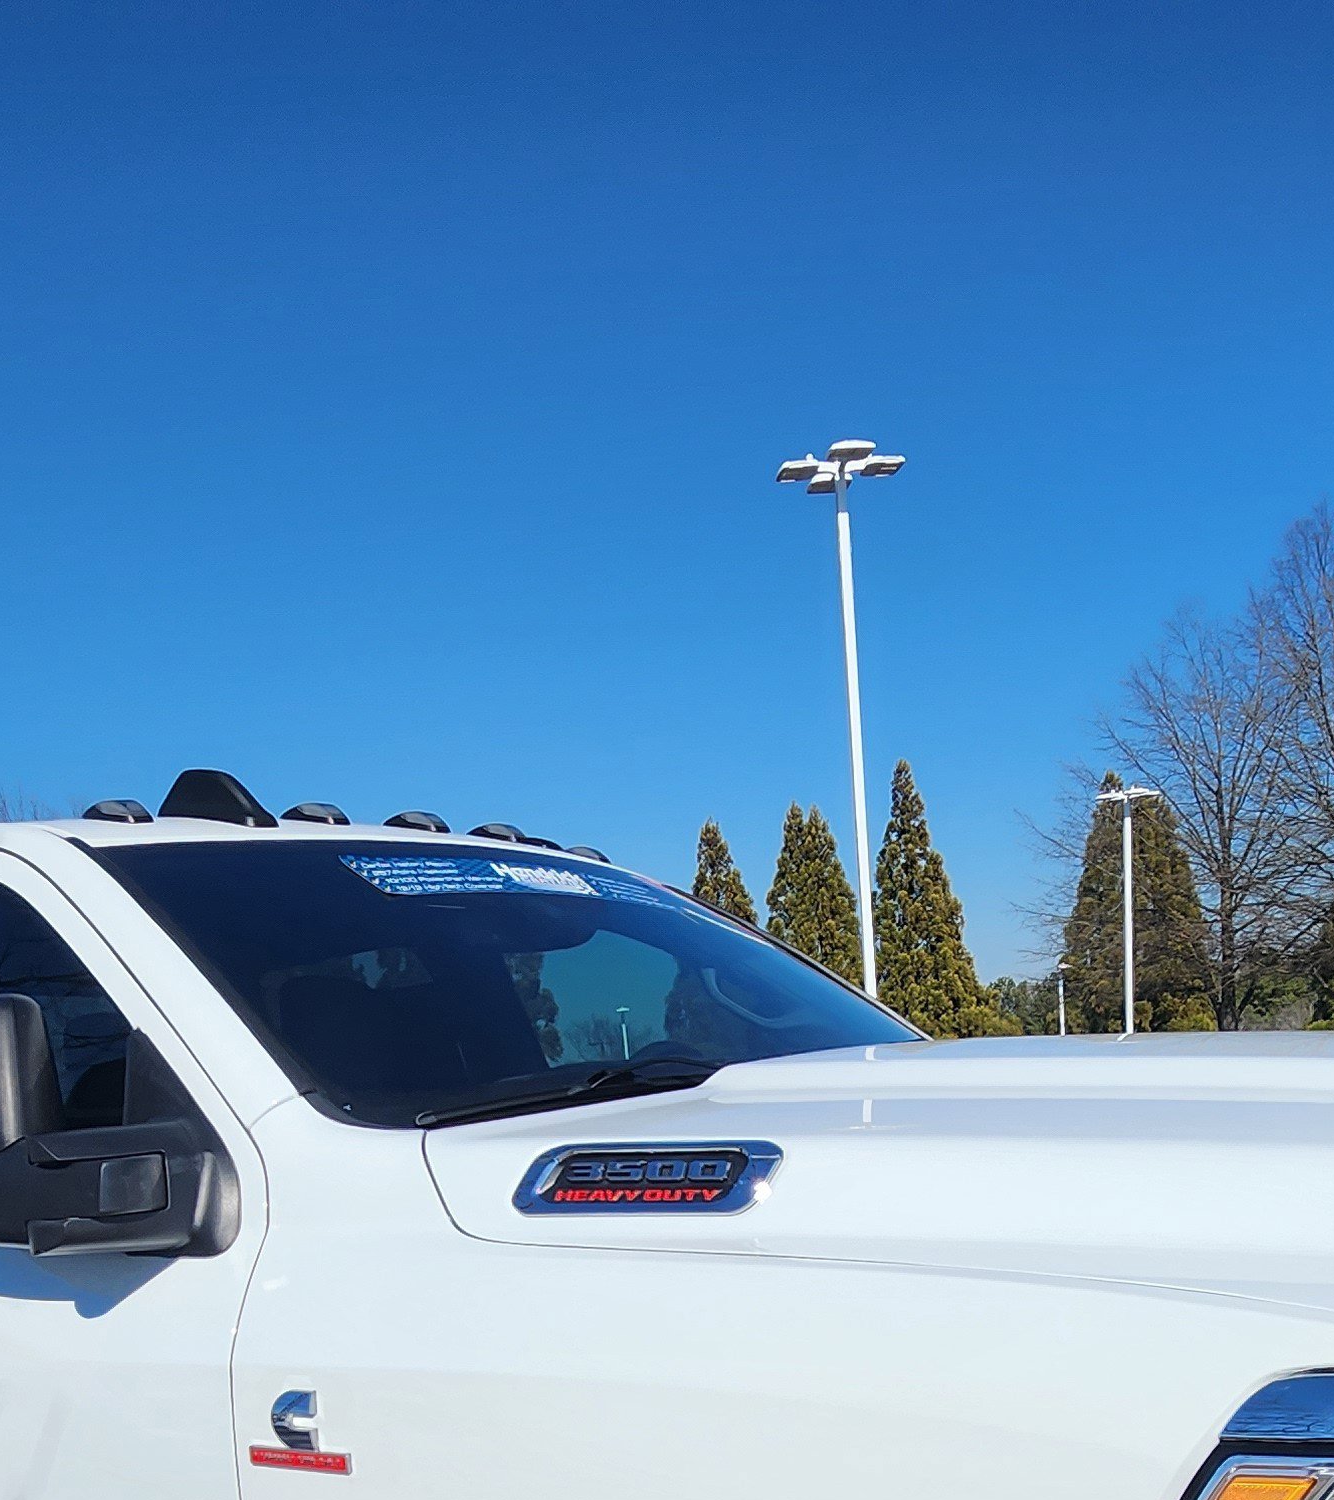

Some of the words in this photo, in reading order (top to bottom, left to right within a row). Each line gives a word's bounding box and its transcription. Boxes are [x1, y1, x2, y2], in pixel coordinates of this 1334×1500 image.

[566, 1159, 732, 1182] 3500
[553, 1188, 643, 1203] HEAVY
[643, 1188, 723, 1202] DUTY
